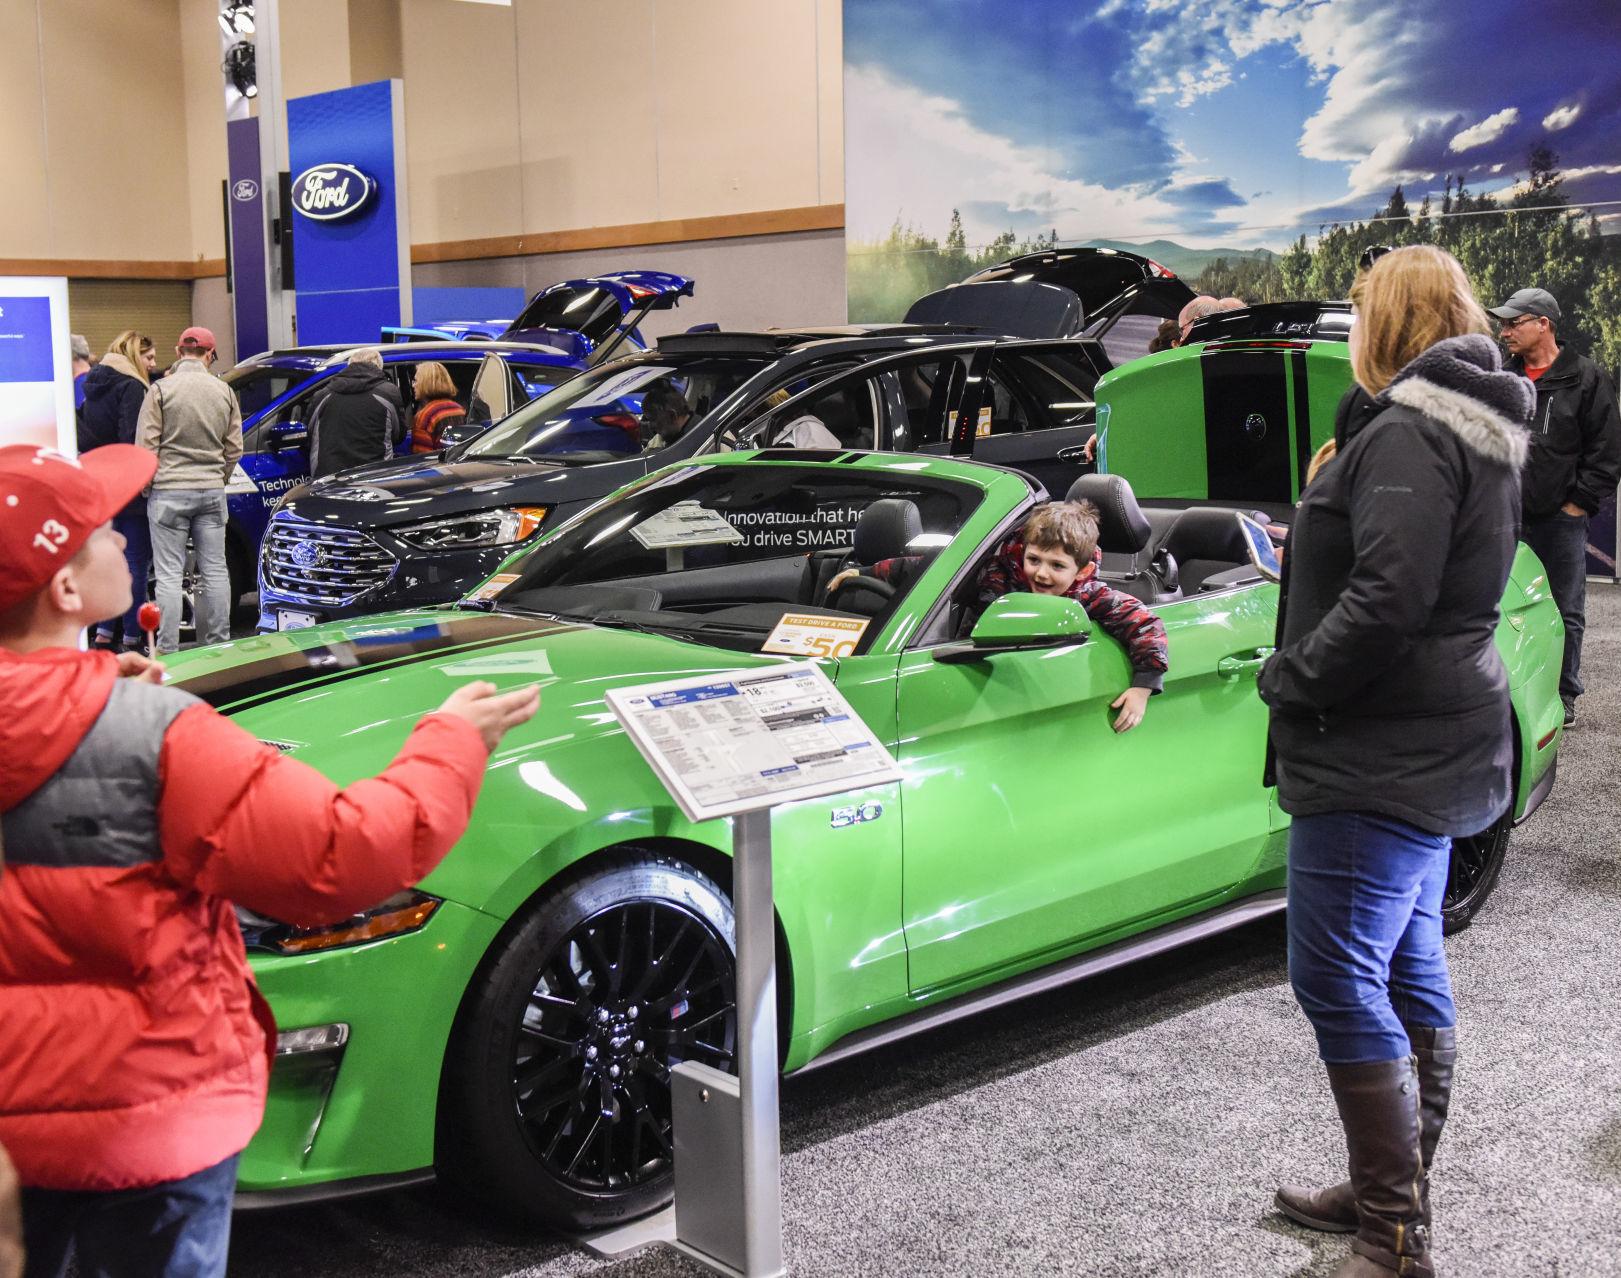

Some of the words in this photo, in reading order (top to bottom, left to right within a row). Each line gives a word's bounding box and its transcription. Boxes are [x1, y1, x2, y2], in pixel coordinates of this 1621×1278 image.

[236, 182, 254, 198] Ford
[302, 170, 349, 210] Ford
[812, 507, 844, 523] that
[33, 519, 70, 554] 13
[754, 531, 792, 546] drive
[837, 621, 858, 630] FORD
[831, 799, 882, 829] 5.0
